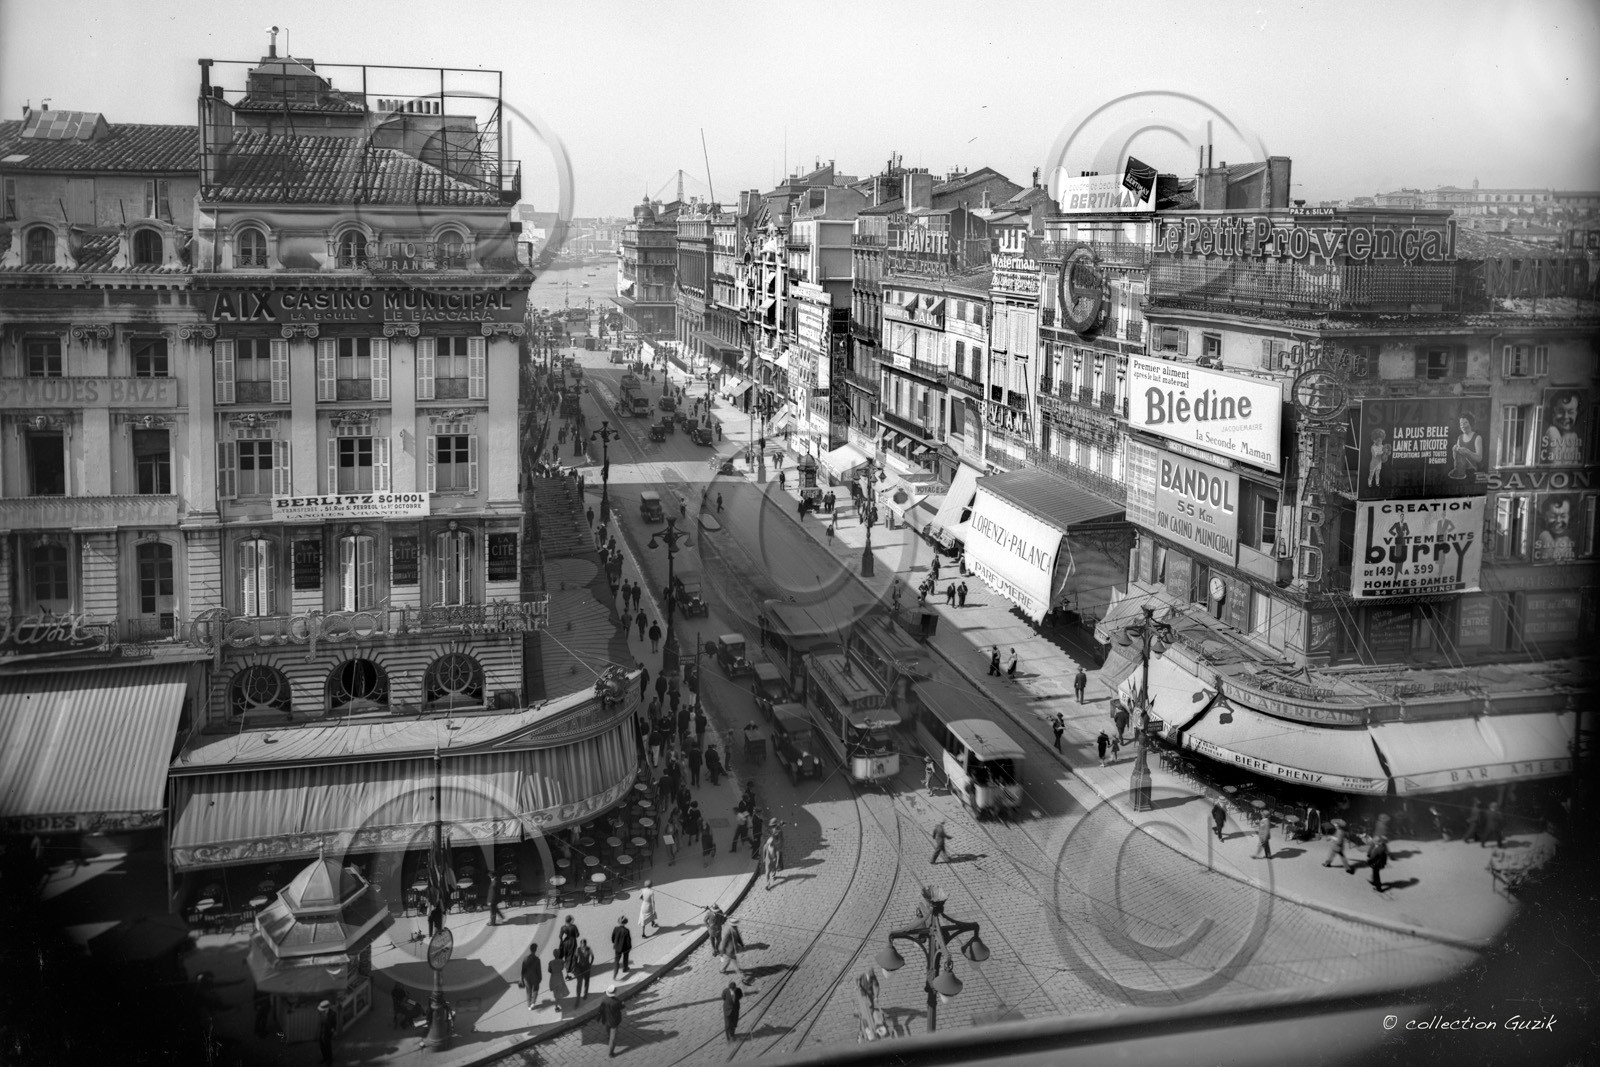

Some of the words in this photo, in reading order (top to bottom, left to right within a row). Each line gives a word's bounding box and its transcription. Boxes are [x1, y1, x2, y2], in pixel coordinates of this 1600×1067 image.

[1069, 190, 1143, 209] BERTIMAY
[326, 241, 472, 260] VICTORIA
[896, 230, 949, 254] LAFAYETTE
[1153, 217, 1179, 254] Le
[1183, 216, 1245, 256] Petit
[1250, 215, 1458, 269] Provençal
[352, 260, 448, 272] ASSURANCES
[991, 253, 1036, 271] Waterman
[211, 293, 277, 322] AIX
[281, 293, 373, 310] CASINO
[383, 293, 512, 310] MUNICIPAL
[291, 313, 306, 321] LA
[313, 313, 358, 321] BOULE
[384, 311, 403, 322] LE
[411, 311, 495, 322] BACCARA
[1278, 339, 1368, 377] COGNAC
[1133, 360, 1160, 373] Premier
[1162, 366, 1190, 380] aliment
[1162, 376, 1190, 389] maternel
[1145, 387, 1252, 425] Blédine
[1221, 424, 1263, 433] JACQUEMAIRE
[1393, 427, 1404, 439] LA
[1405, 427, 1425, 439] PLUS
[1426, 426, 1449, 438] BELLE
[1196, 429, 1203, 441] la
[1205, 431, 1237, 451] Seconde
[1241, 442, 1272, 462] Maman
[1392, 440, 1412, 452] LAINE
[1413, 440, 1417, 451] A
[1419, 439, 1448, 451] TRICOTER
[1541, 436, 1583, 448] Savon
[1160, 459, 1234, 515] BANDOL
[1487, 471, 1592, 490] SAVON
[276, 495, 374, 508] BERLITZ
[379, 494, 425, 504] SCHOOL
[1381, 501, 1473, 514] CREATION
[286, 511, 344, 519] LANGUES
[1177, 500, 1195, 517] 55
[1199, 508, 1215, 524] Km.
[1157, 511, 1169, 529] SON
[1170, 516, 1193, 540] CASINO
[1194, 526, 1234, 558] MUNICIPAL
[1364, 569, 1374, 577] DE
[1375, 566, 1394, 577] 149
[1404, 568, 1410, 576] A
[1413, 564, 1434, 575] 399
[974, 561, 1034, 611] PARFUMERIE
[1409, 585, 1457, 594] BELSUNCE
[493, 601, 549, 617] MARQUE
[856, 696, 887, 709] KUB
[1226, 686, 1252, 704] BAR
[1258, 699, 1360, 722] AMERICAIN
[1235, 754, 1269, 771] BIERE
[1277, 767, 1323, 783] PHENIX
[1450, 767, 1489, 782] BAR
